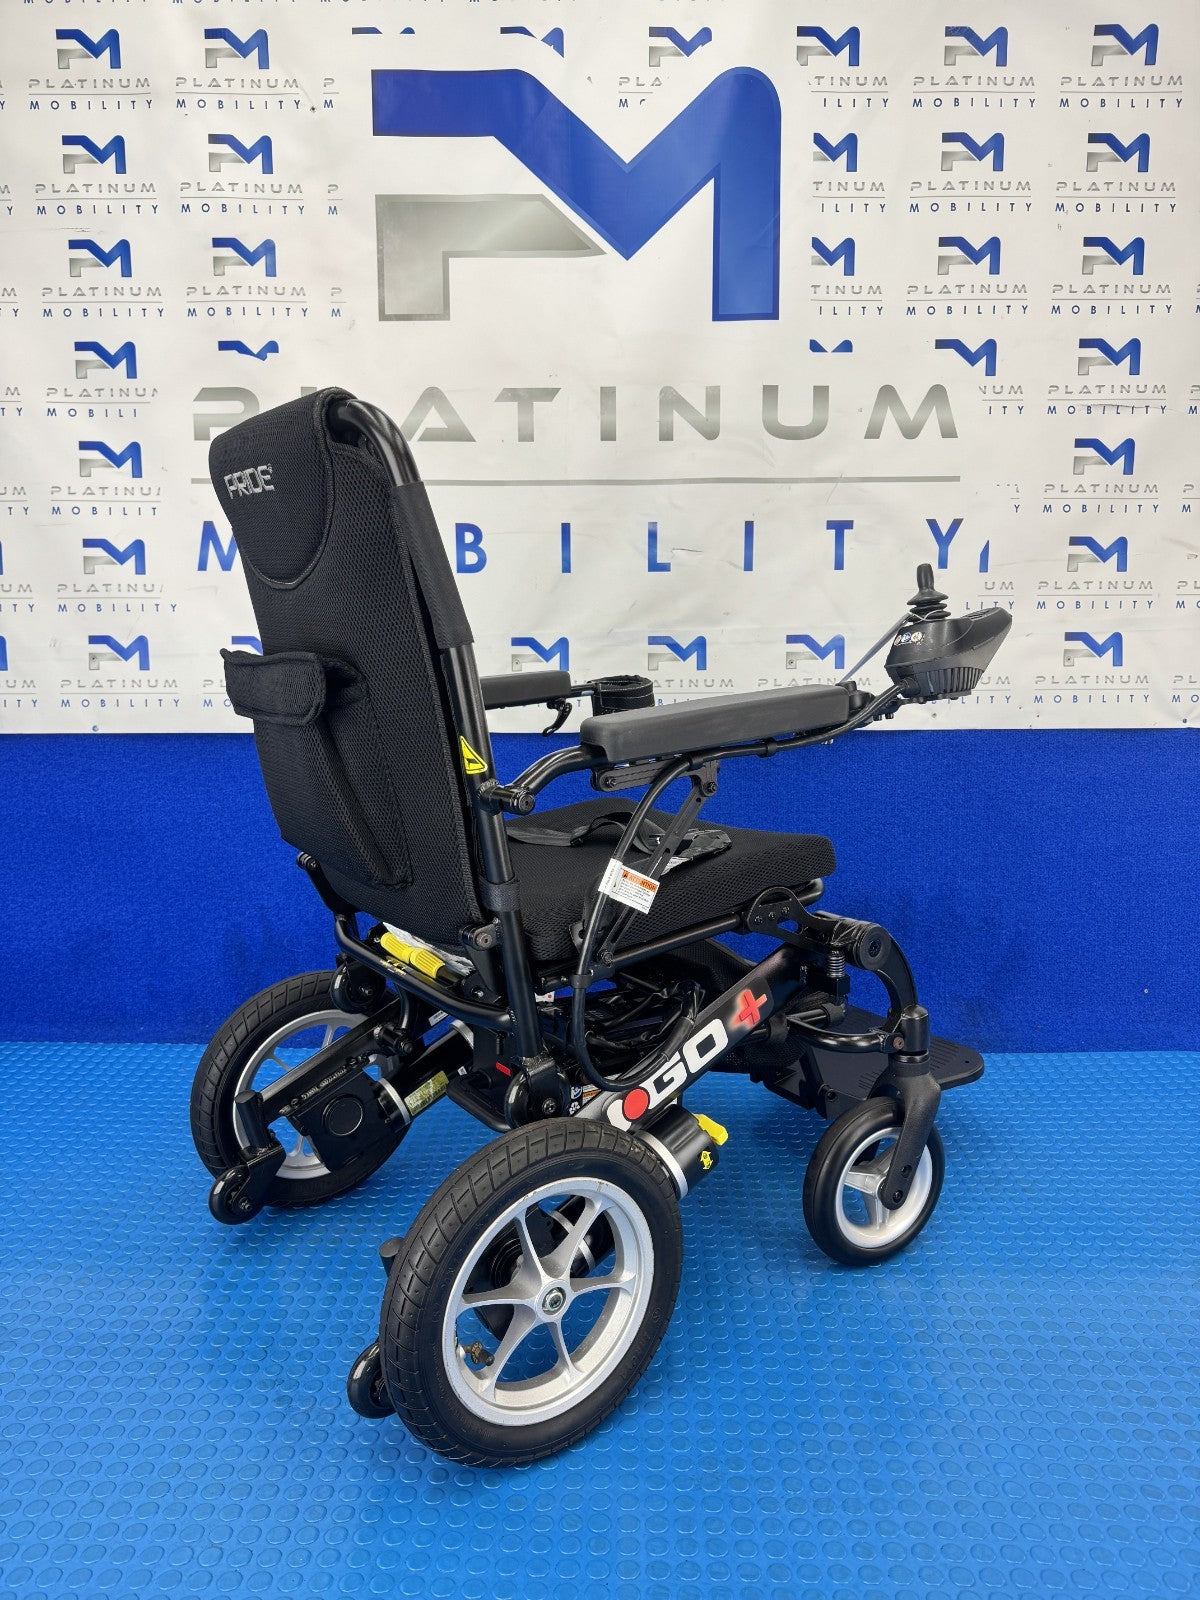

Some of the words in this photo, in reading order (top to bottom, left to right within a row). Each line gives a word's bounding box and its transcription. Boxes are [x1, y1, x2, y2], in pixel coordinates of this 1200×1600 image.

[29, 77, 151, 89] PLATINUM
[176, 76, 299, 89] PLATINUM
[808, 75, 889, 87] TINUM
[914, 75, 1036, 87] PLATINUM
[1061, 74, 1184, 87] PLATINUM
[30, 99, 153, 111] MOBILITY
[176, 98, 301, 110] MOBILITY
[913, 97, 1036, 108] MOBILITY
[1059, 97, 1183, 109] MOBILITY
[34, 182, 157, 194] PLATINUM
[180, 181, 303, 194] PLATINUM
[911, 180, 1032, 192] PLATINUM
[1056, 181, 1176, 192] PLATINUM
[37, 204, 159, 216] MOBILITY
[181, 202, 305, 215] MOBILITY
[910, 201, 1033, 213] MOBILITY
[1055, 202, 1177, 213] MOBILITY
[42, 286, 162, 297] PLATINUM
[187, 285, 307, 297] PLATINUM
[907, 283, 1028, 295] PLATINUM
[1053, 283, 1172, 295] PLATINUM
[43, 307, 164, 318] MOBILITY
[188, 306, 309, 318] MOBILITY
[906, 304, 1029, 316] MOBILITY
[1051, 304, 1173, 315] MOBILITY
[1048, 383, 1167, 395] PLATINUM
[193, 384, 959, 443] PATINUM
[1047, 405, 1167, 416] MOBILITY
[51, 485, 161, 497] PLATINU
[1044, 483, 1159, 494] PLATINUM
[1043, 503, 1159, 514] MOBILITY
[197, 517, 964, 574] MBILITY
[57, 583, 164, 593] PLATINU
[1038, 580, 1153, 590] PLATINUM
[58, 603, 177, 613] MOBILITY
[1037, 600, 1154, 610] MOBILITY
[61, 679, 179, 689] PLATINUM
[1035, 674, 1150, 685] PLATINUM
[61, 698, 180, 708] MOBILITY
[1034, 694, 1150, 704] MOBILITY
